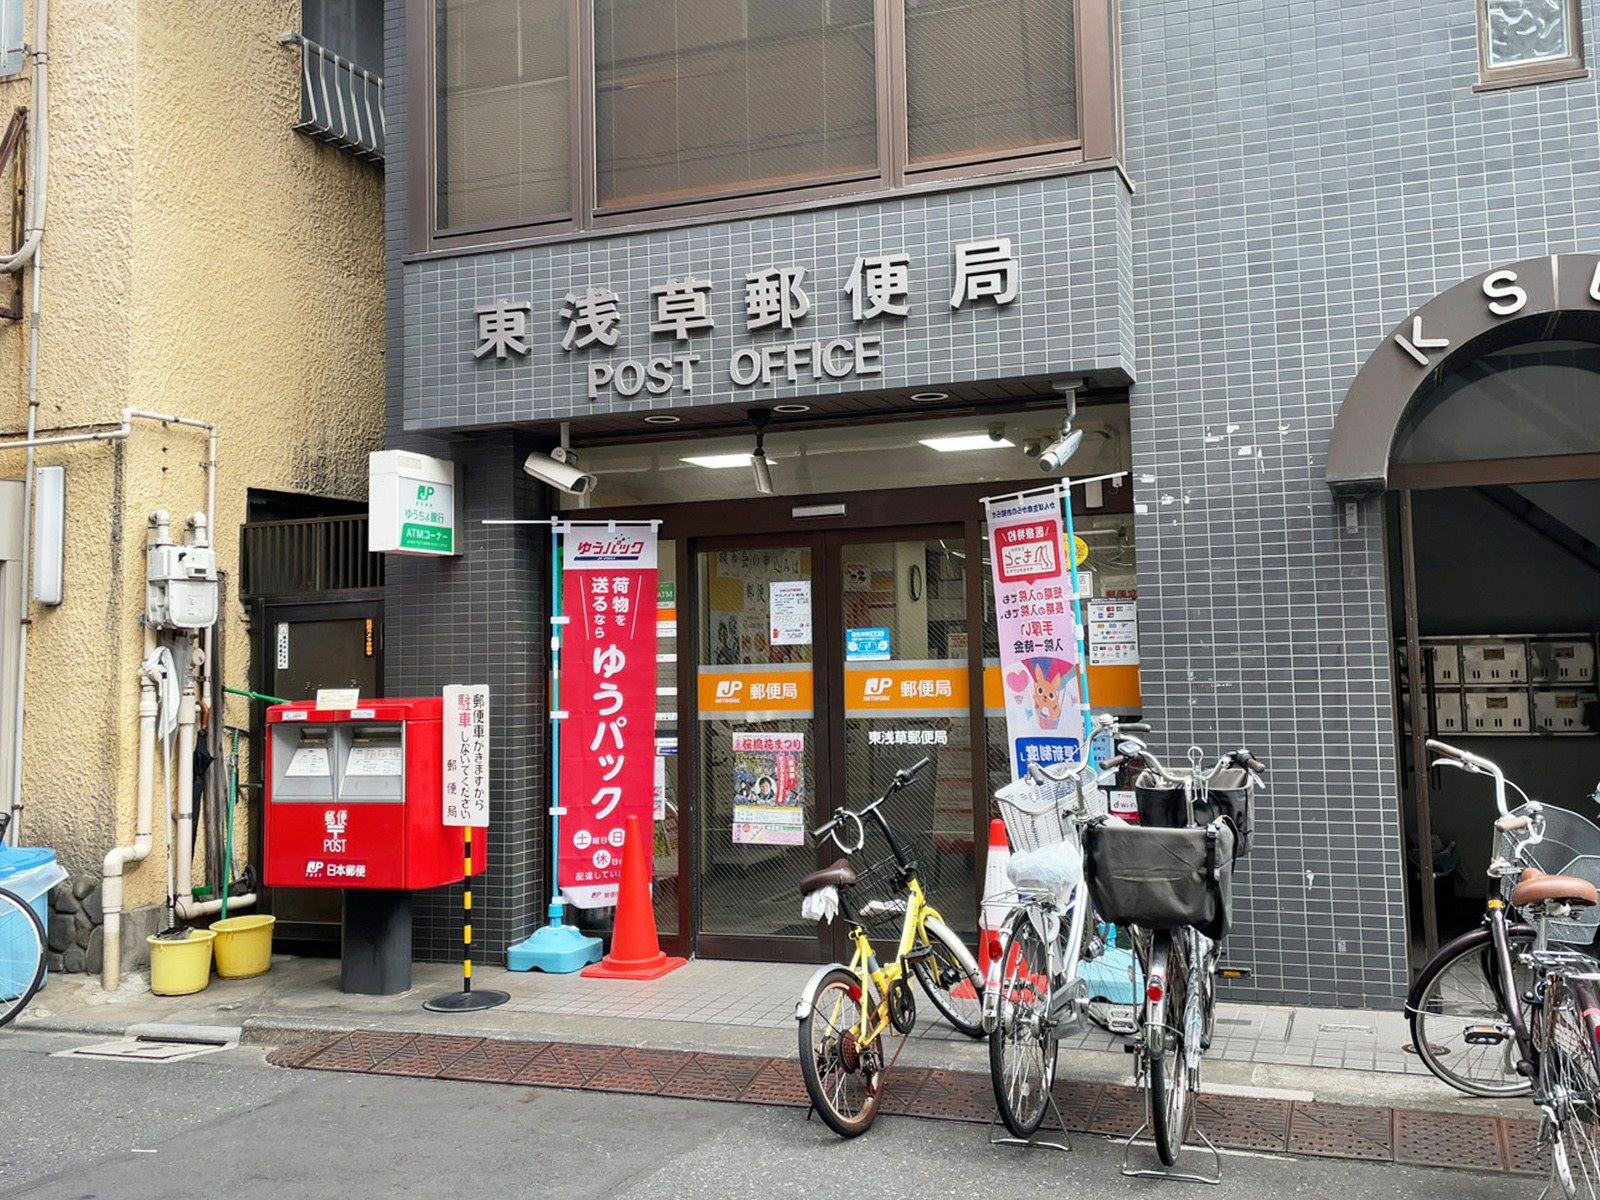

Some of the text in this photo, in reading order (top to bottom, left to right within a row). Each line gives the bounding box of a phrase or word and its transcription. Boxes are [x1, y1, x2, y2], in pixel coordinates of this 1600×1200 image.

[471, 237, 1019, 359] 東浅草郵便局
[588, 335, 882, 399] POST OFFICE
[405, 509, 445, 524] ゆうちょ銀行
[406, 528, 448, 541] ATMコーナー
[577, 540, 645, 555] ゆうパック
[591, 576, 609, 639] 送るなら
[612, 576, 630, 627] 荷物を
[716, 680, 743, 698] JP
[750, 682, 797, 700] 郵便局
[864, 678, 893, 695] JP
[900, 680, 952, 698] 郵便局
[590, 644, 628, 820] ゆうパック
[868, 730, 948, 745] 東浅草郵便局
[473, 694, 485, 811] 郵便車がきますから
[447, 759, 457, 819] 郵便局
[324, 810, 348, 826] 郵便
[323, 839, 347, 853] POST
[596, 852, 622, 866] 休日
[327, 864, 366, 878] 日本郵便
